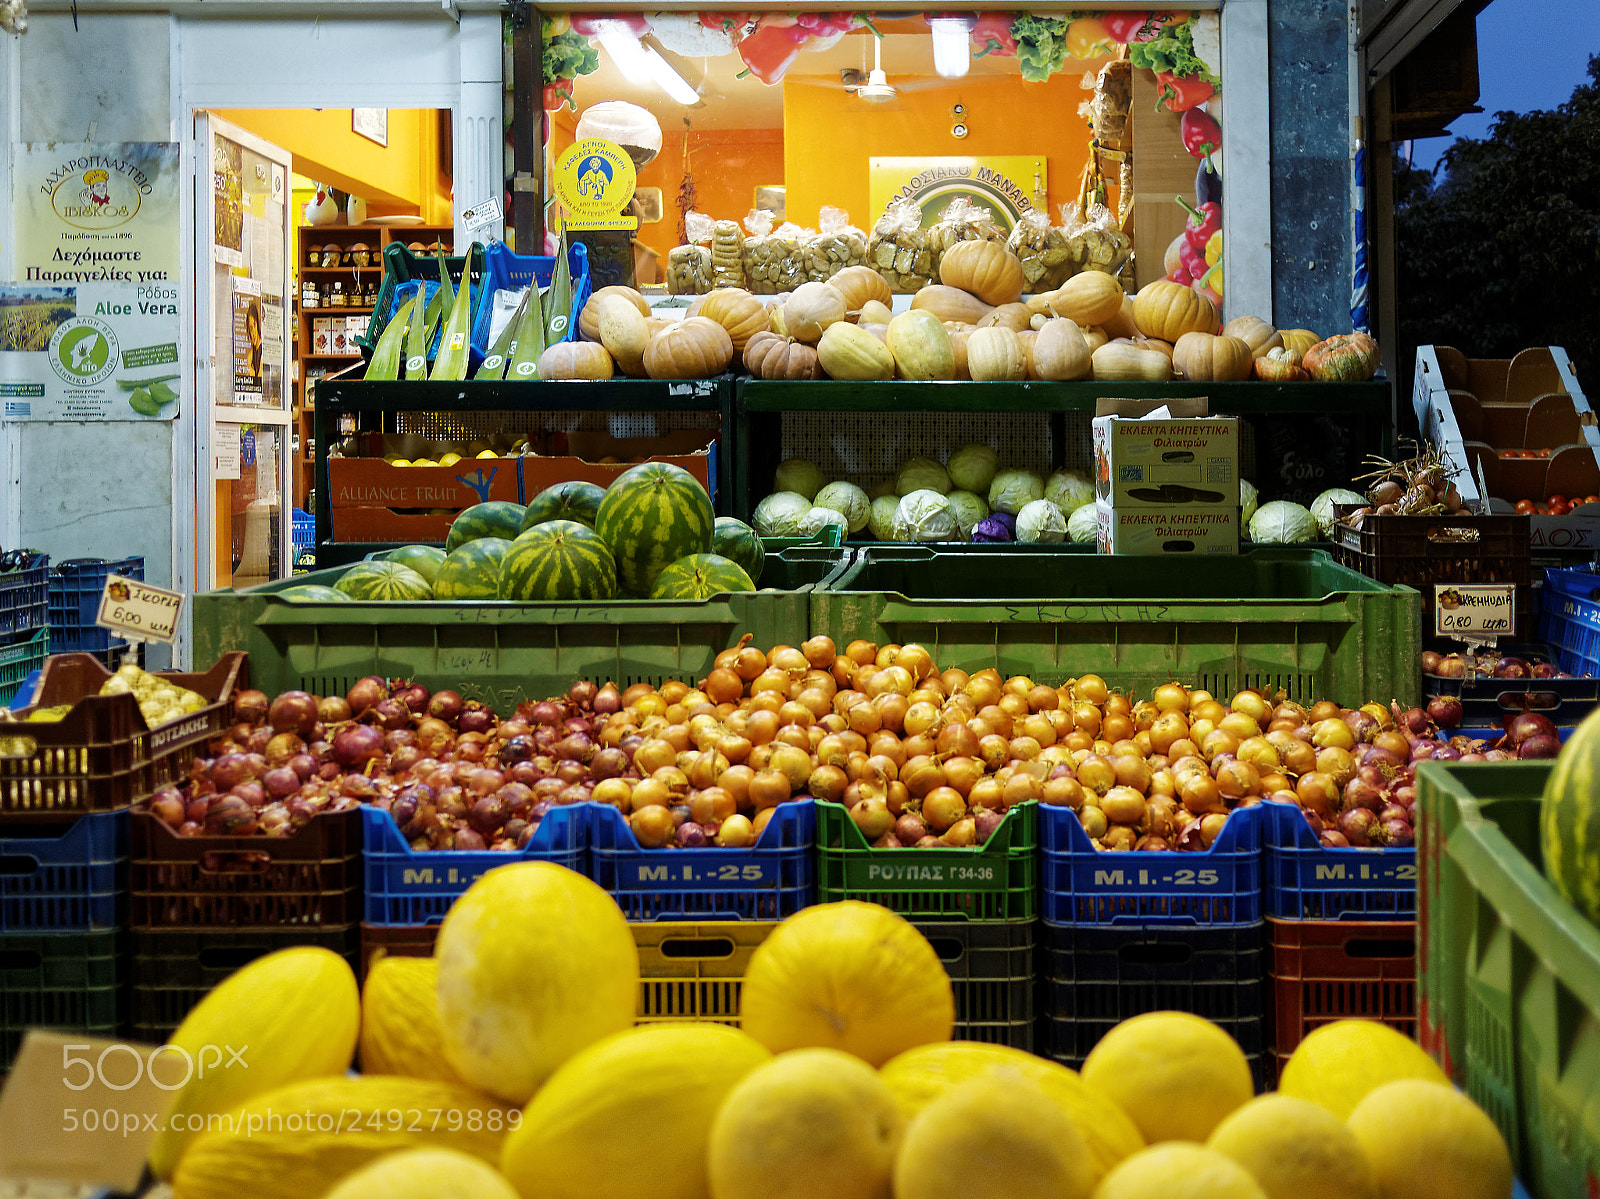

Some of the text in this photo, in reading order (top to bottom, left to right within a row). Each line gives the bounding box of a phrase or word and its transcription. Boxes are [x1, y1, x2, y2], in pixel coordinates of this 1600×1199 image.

[582, 141, 606, 149] ΑΓΝΟΙ
[563, 148, 626, 171] ΚΑΦΕΔΕΣ ΚΑΜΠΕΡΗ
[40, 156, 153, 196] ΖΑΧΑΡΟΠΛΑΣΤΕΙΟ
[52, 246, 142, 266] Δεχόμαστε
[26, 266, 167, 282] Παραγγελίες για:
[137, 286, 177, 300] Ρόδος
[94, 302, 177, 316] Aloe Vera
[1120, 425, 1229, 435] ΕΚΛΕΚΤΑ ΚΗΠΕΥΤΙΚΑ
[1153, 438, 1208, 449] Φιλιατρών
[340, 486, 458, 501] ALLIANCE FRUIT
[1120, 515, 1167, 525] ΕΚΛΕΚΤΑ
[1170, 514, 1230, 524] ΚΗΠΕΥΤΙΚΑ
[1155, 527, 1209, 538] Φιλιατρών
[113, 606, 142, 625] 6,00
[1443, 615, 1472, 629] 0,80
[638, 865, 763, 881] M.I.-25
[869, 864, 994, 882] ΡΟΥΠΑΣ Γ34-36
[1094, 869, 1220, 886] M.I.-25
[1315, 864, 1416, 880] M.I.-2
